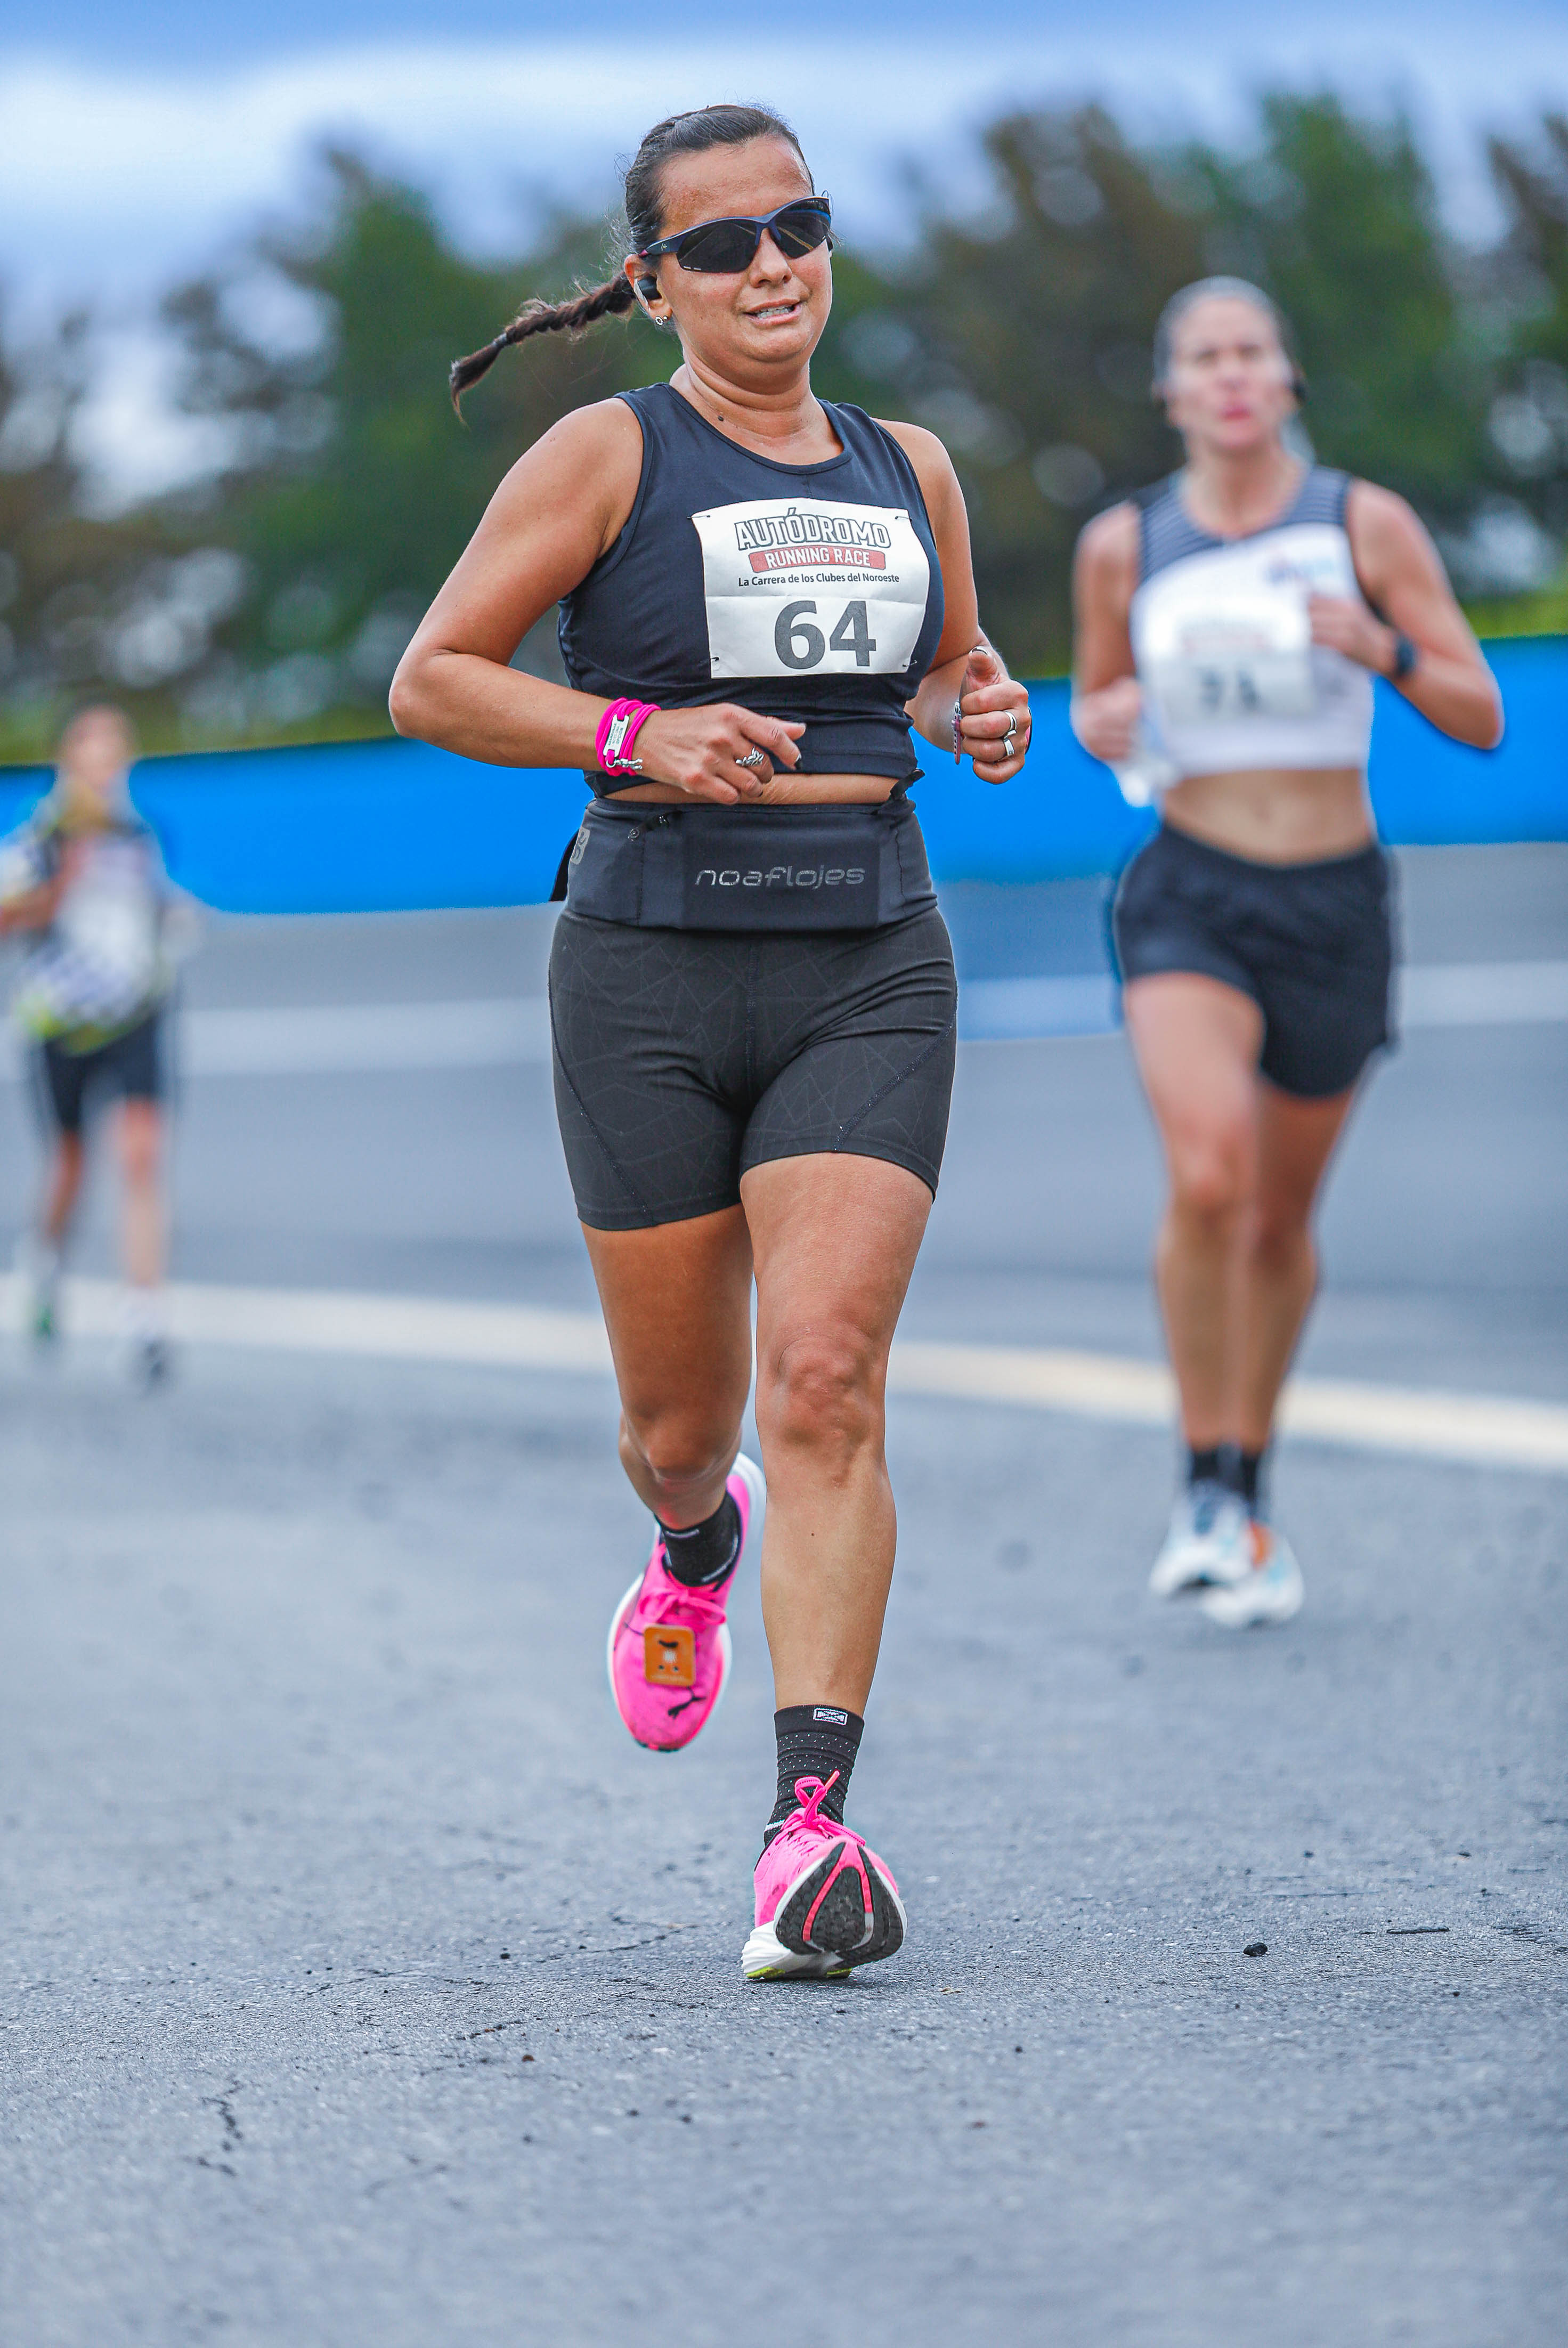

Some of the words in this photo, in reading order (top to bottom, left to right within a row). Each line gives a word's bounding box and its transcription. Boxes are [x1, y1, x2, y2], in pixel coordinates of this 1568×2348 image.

[734, 507, 891, 550] AUTÓDROMO
[765, 547, 830, 568] RUNNING
[833, 548, 871, 566] RACE
[738, 578, 749, 587] La
[751, 574, 785, 586] Carrera
[789, 574, 799, 583] de
[801, 574, 814, 583] los
[816, 573, 846, 582] Clubes
[847, 573, 860, 582] del
[863, 573, 899, 583] Noroeste
[774, 600, 876, 669] 64
[695, 865, 865, 890] noaflojes
